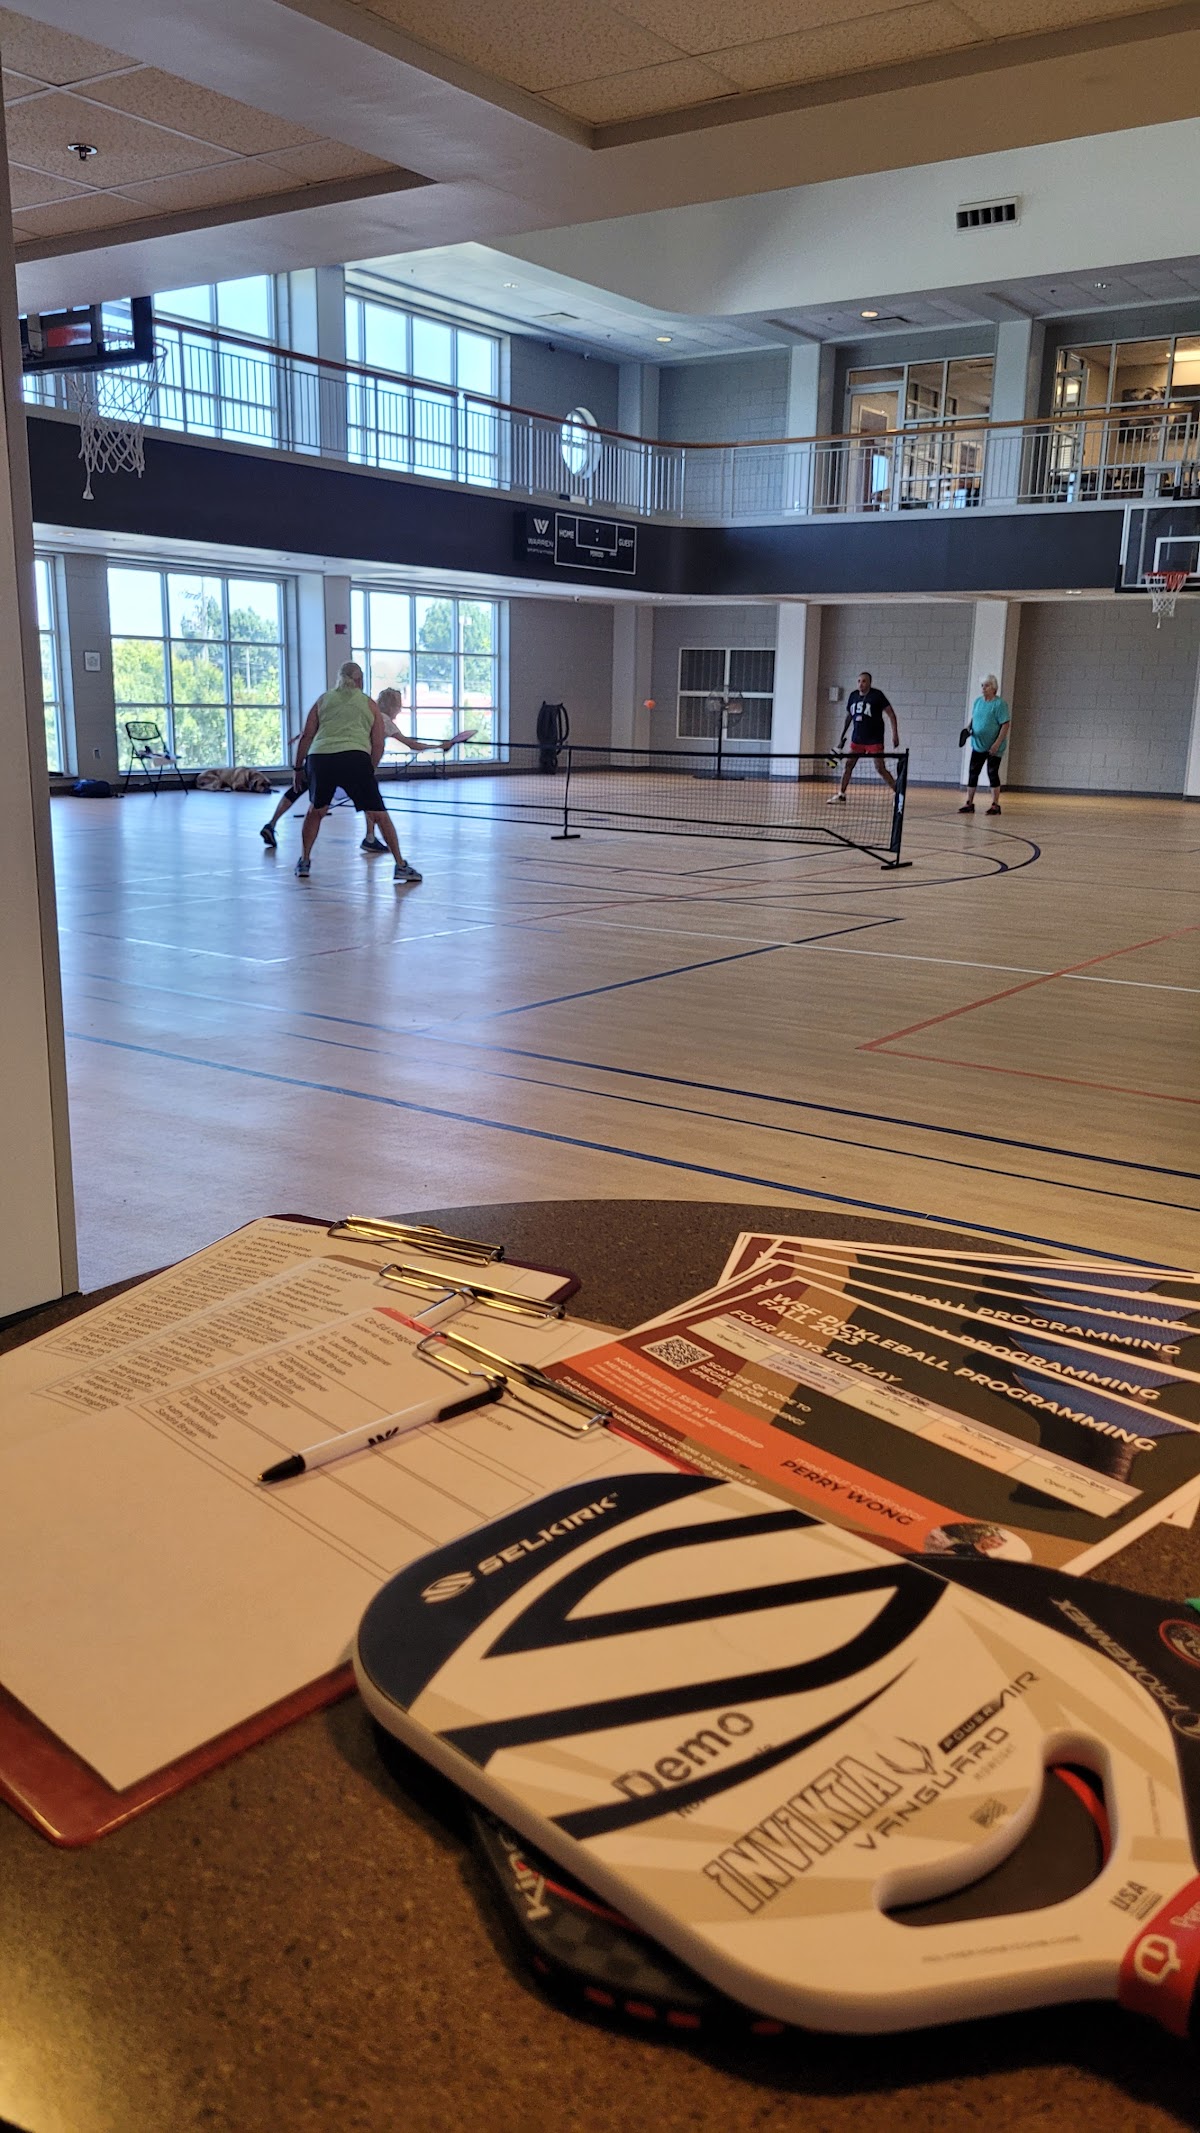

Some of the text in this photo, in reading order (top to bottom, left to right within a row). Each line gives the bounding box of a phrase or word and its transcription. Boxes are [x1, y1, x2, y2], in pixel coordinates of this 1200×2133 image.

[527, 537, 554, 548] WARREN
[558, 529, 575, 539] HOME
[618, 538, 634, 548] GUEST
[850, 702, 872, 718] USA
[318, 1262, 342, 1271] Co-Ed
[340, 1270, 368, 1280] League
[274, 1291, 298, 1300] Andrea
[256, 1316, 275, 1324] Barry
[366, 1317, 387, 1329] Co-Ed
[386, 1329, 414, 1345] League
[757, 1298, 864, 1346] FALL 2023
[975, 1307, 1181, 1355] PROGRAMMING
[329, 1341, 368, 1364] Laura Rollins
[341, 1336, 358, 1346] Kathy
[729, 1309, 777, 1333] FOUR
[776, 1330, 828, 1354] WAYS
[826, 1351, 853, 1364] TO
[852, 1362, 903, 1383] PLAY
[277, 1360, 295, 1371] Kathy
[286, 1357, 321, 1378] Dennis Lam
[305, 1350, 345, 1374] Sandra Bryan
[317, 1345, 351, 1366] Dennis Lam
[239, 1376, 258, 1387] Kathy
[255, 1369, 295, 1393] Laura Rollins
[264, 1366, 305, 1391] Sandra Bryan
[613, 1357, 677, 1392] NON-MEMBERS
[698, 1365, 764, 1397] REGISTER FOR
[773, 1293, 823, 1316] WSF
[819, 1314, 949, 1372] PICKLEBALL
[954, 1367, 1158, 1450] PROGRAMMING
[216, 1385, 252, 1407] Dennis Lam
[229, 1380, 270, 1404] Laura Rollins
[688, 1368, 729, 1388] SPECIAL
[727, 1387, 806, 1425] PROGRAMMING!
[706, 1361, 813, 1412] SCAN THE QR CODE TO
[165, 1405, 184, 1417] Kathy
[179, 1400, 221, 1425] Laura Rollins
[190, 1396, 225, 1418] Dennis Lam
[206, 1388, 248, 1415] Sandra Bryan
[604, 1361, 646, 1384] MEMBERS
[649, 1387, 693, 1412] INCLUDED
[702, 1416, 764, 1449] MEMBERSHIP
[155, 1409, 198, 1436] Sandra Bryan
[564, 1376, 759, 1486] PLEASE DIRECT MEMBERSHIP QUESTIONS TO CHARITY AT
[680, 1452, 693, 1460] OR
[691, 1459, 714, 1471] STOP
[780, 1459, 914, 1526] PERRY WONG
[1043, 1478, 1066, 1489] Open
[1067, 1488, 1086, 1499] Play
[477, 1495, 618, 1575] SELKIRK
[610, 1711, 754, 1801] Demo
[853, 1726, 1010, 1850] VANGUARD
[1109, 1880, 1147, 1911] USA
